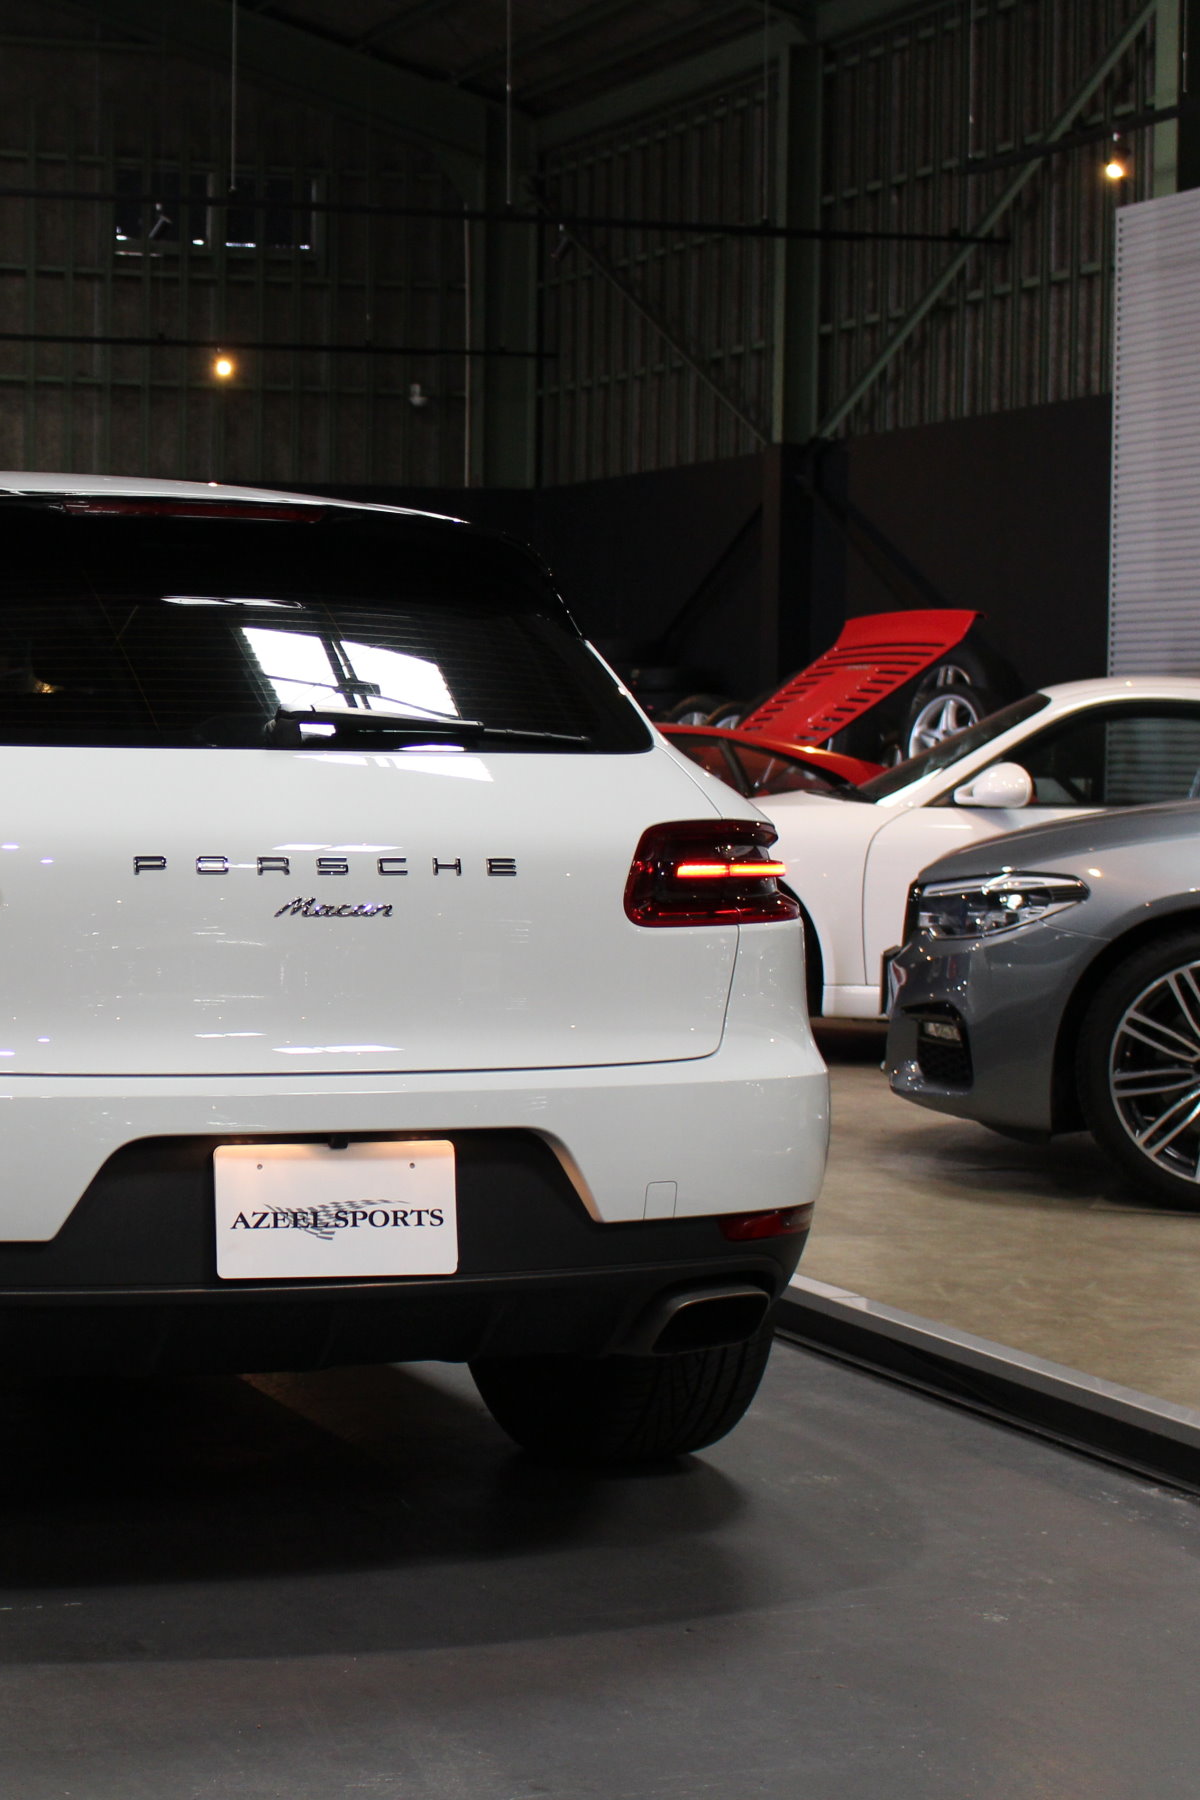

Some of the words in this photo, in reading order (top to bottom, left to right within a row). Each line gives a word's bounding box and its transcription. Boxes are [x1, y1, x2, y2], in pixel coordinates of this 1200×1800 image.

[133, 855, 517, 877] PORSCHE
[274, 895, 393, 918] Macan
[231, 1211, 328, 1229] AZEEL
[334, 1209, 444, 1228] SPORTS
